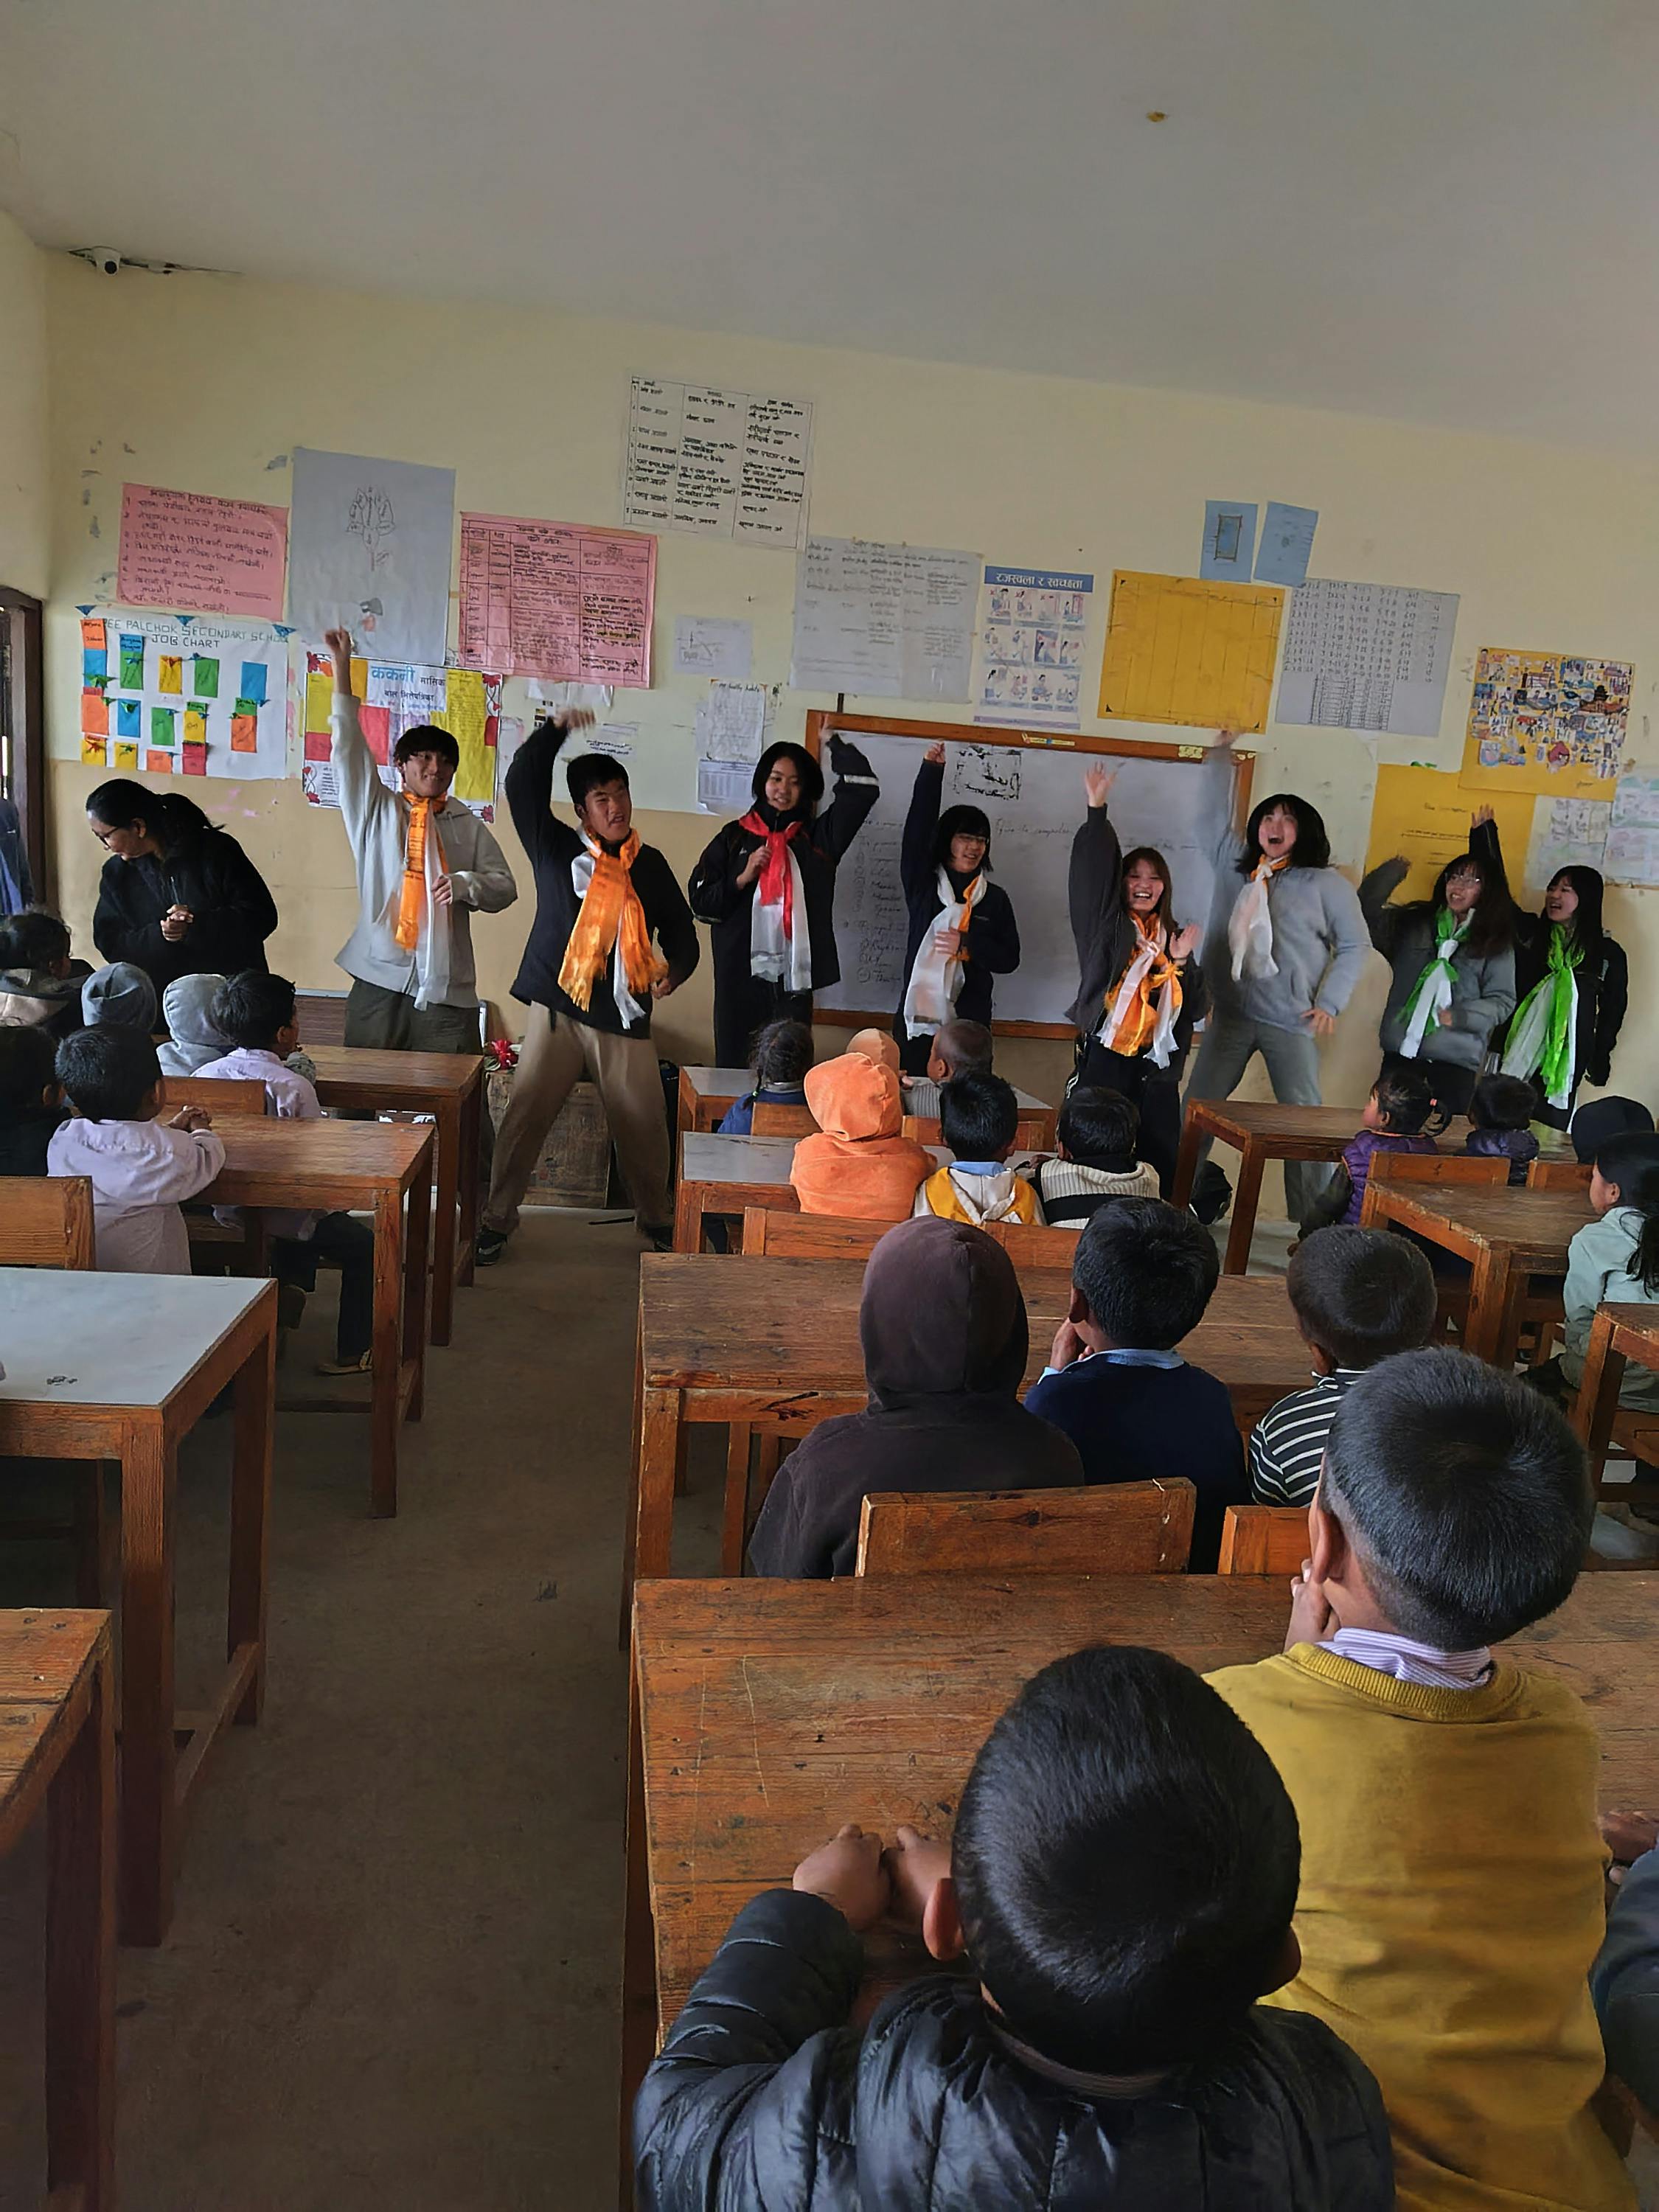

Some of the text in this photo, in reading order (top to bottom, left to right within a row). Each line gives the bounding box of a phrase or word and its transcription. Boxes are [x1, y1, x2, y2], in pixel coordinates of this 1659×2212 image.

[126, 619, 177, 634] PALCHOK
[182, 625, 246, 640] SECONDARY
[152, 633, 178, 646] JOB
[184, 637, 220, 649] CHART
